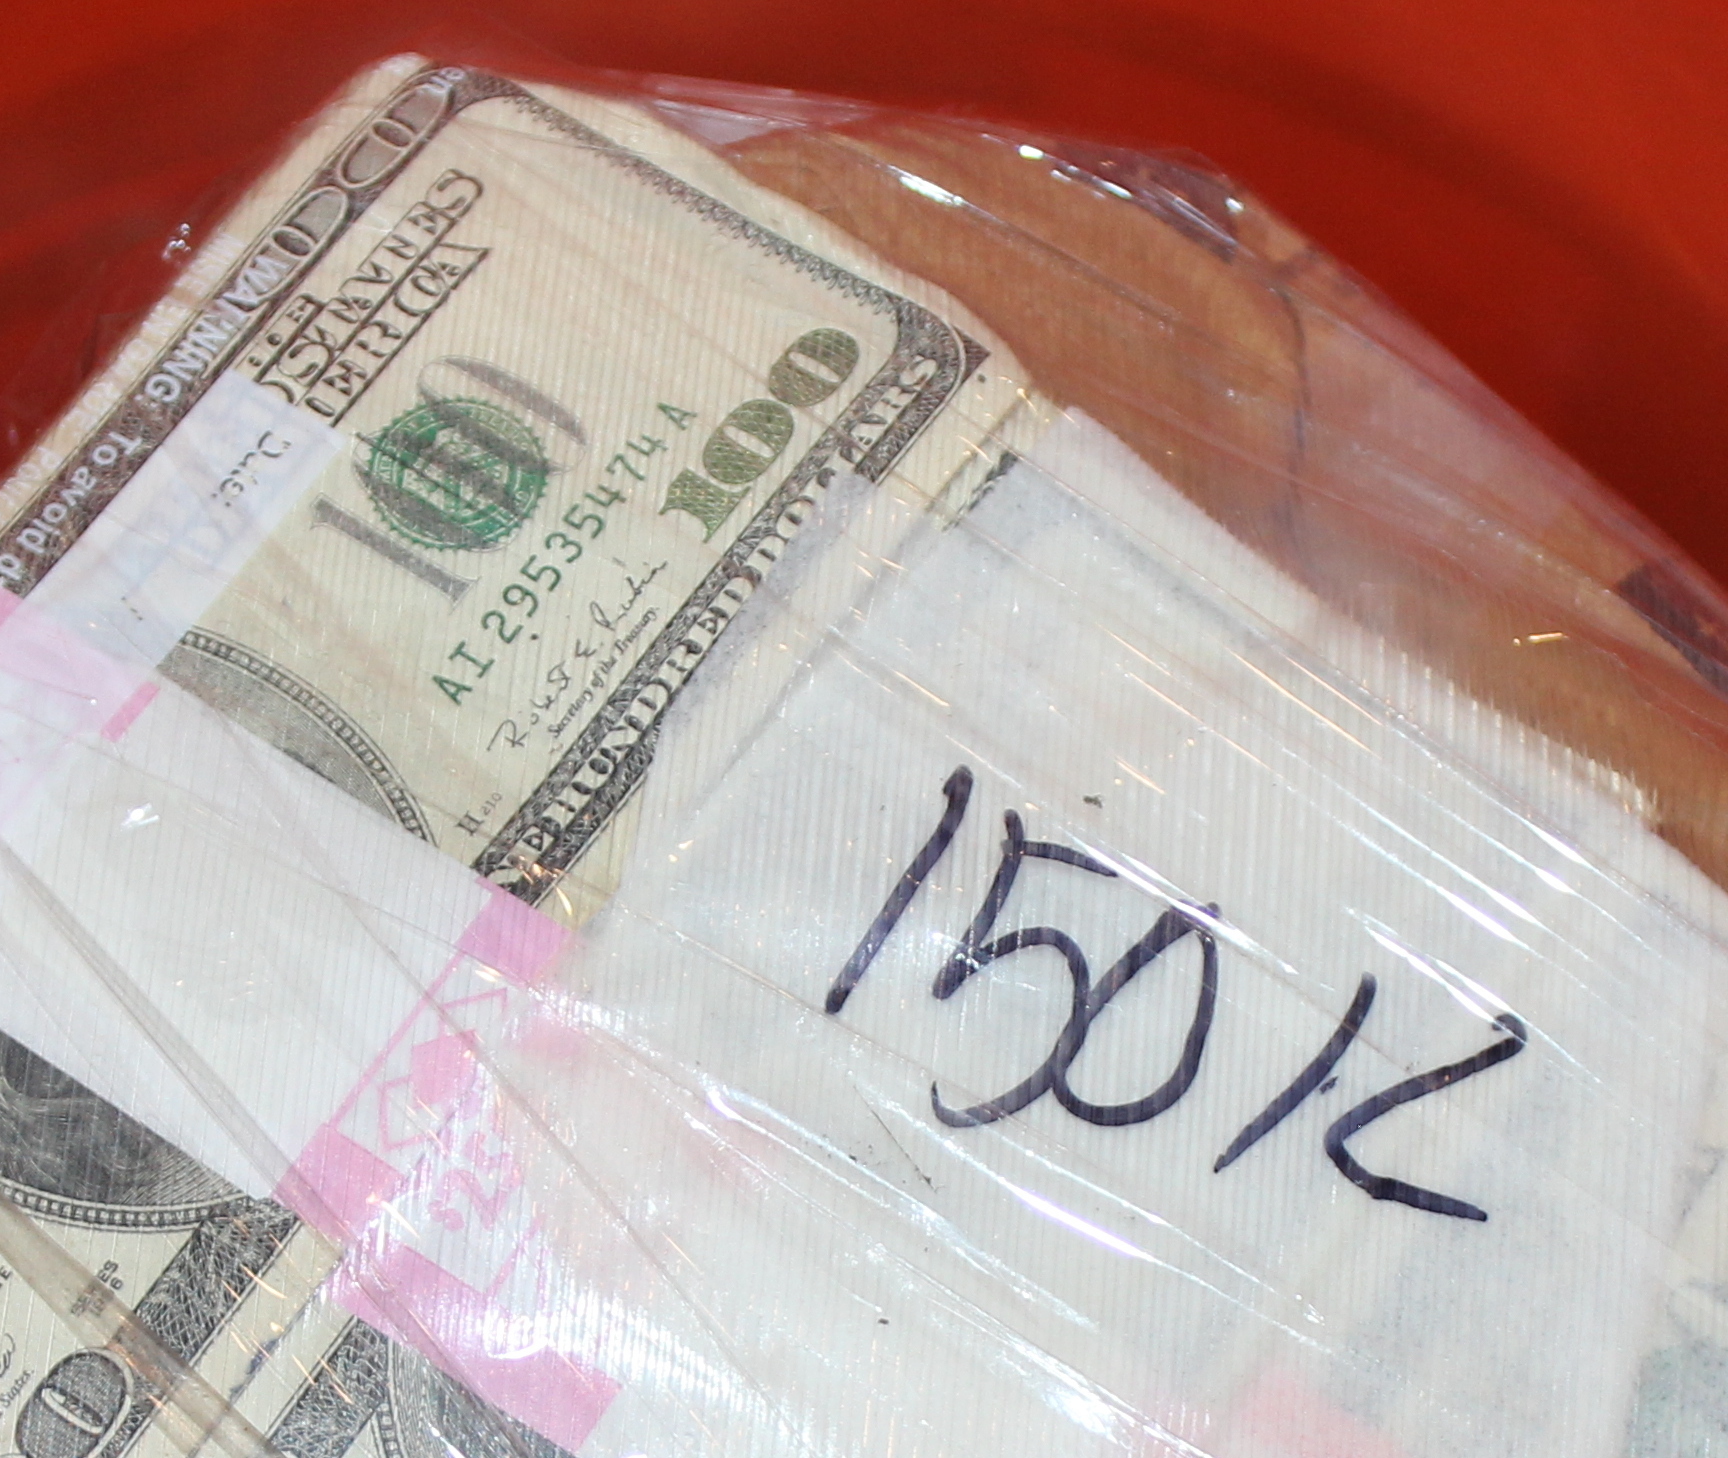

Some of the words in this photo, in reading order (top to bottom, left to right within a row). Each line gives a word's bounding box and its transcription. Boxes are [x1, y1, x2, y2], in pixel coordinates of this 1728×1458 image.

[11, 458, 103, 559] avoid
[85, 418, 143, 477] To
[658, 327, 861, 544] 100
[427, 637, 495, 708] AI
[477, 426, 671, 646] 29535474
[653, 389, 699, 433] A
